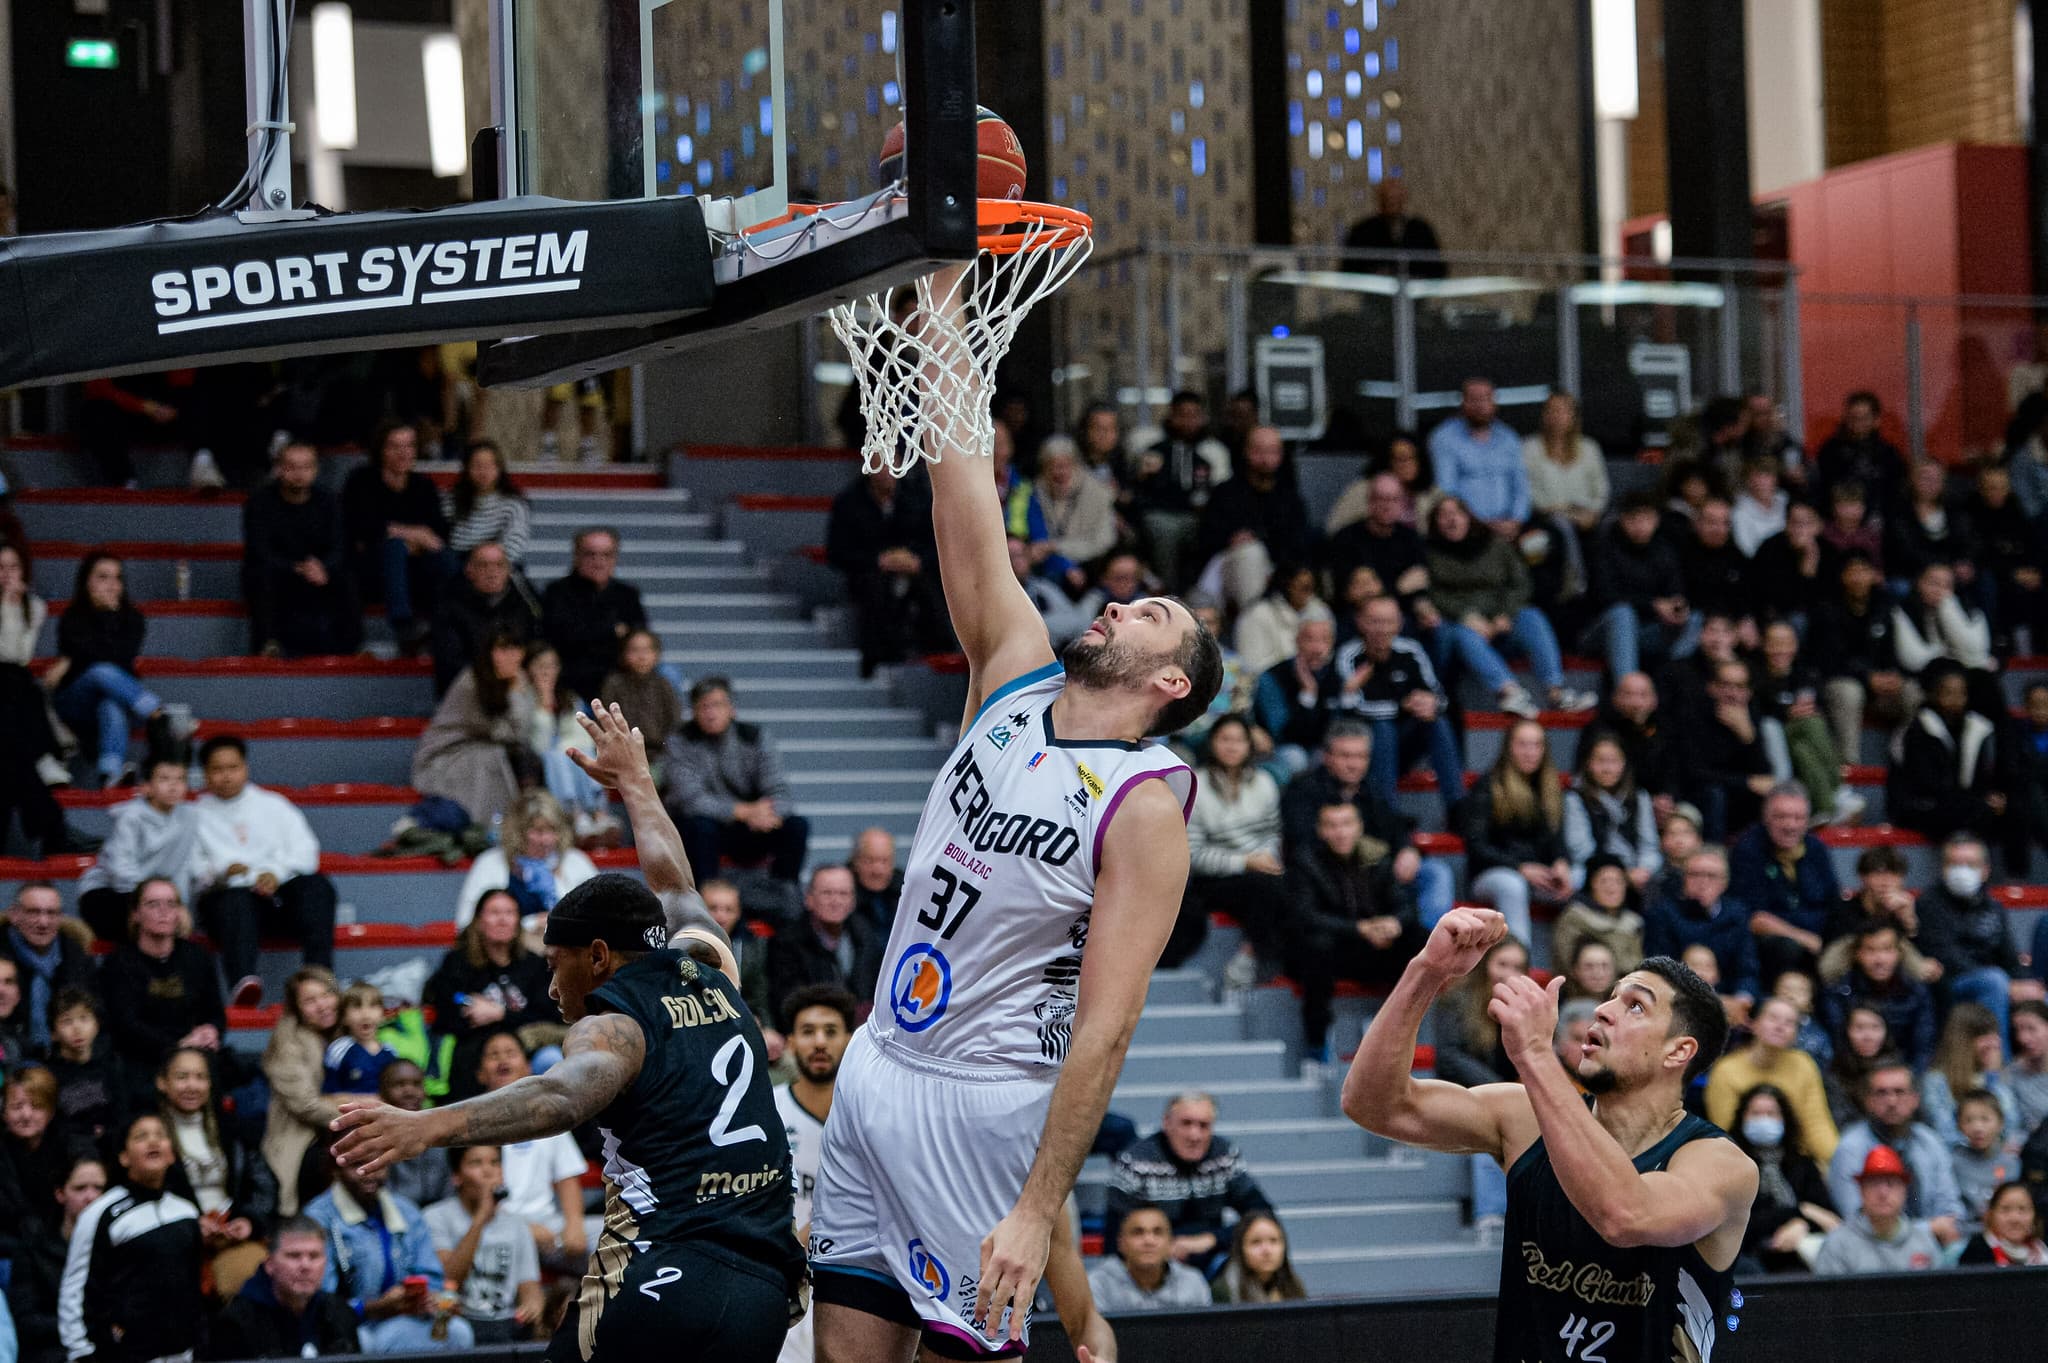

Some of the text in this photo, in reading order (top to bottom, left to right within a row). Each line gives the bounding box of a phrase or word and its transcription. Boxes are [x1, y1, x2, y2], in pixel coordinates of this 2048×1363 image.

[151, 229, 589, 317] SPORT SYSTEM
[945, 742, 1080, 866] PERIGORD
[1063, 795, 1086, 818] SEAT
[943, 842, 993, 880] BOULAZAC
[917, 864, 982, 941] 37
[709, 1034, 767, 1147] 2
[639, 1266, 682, 1301] 2
[1559, 1312, 1616, 1363] 42
